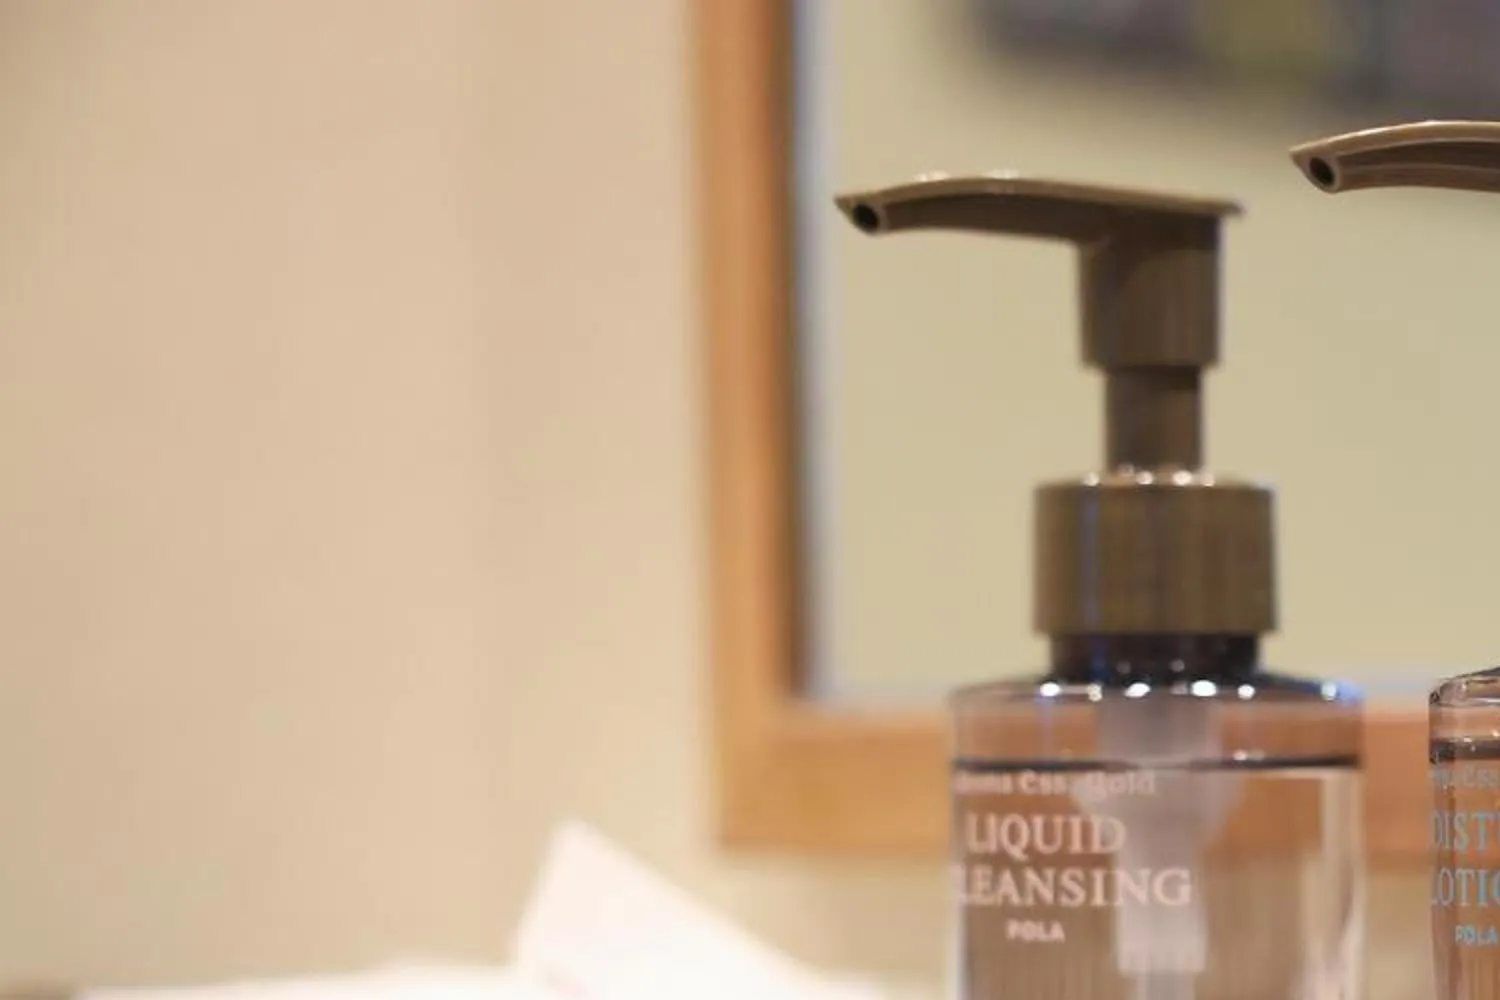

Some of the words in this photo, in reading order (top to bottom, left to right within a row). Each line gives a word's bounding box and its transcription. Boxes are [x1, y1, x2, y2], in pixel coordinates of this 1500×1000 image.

[965, 812, 1127, 862] LIQUID
[949, 864, 1193, 907] LEANSING
[1006, 918, 1066, 943] POLA
[1455, 923, 1500, 946] POLA
